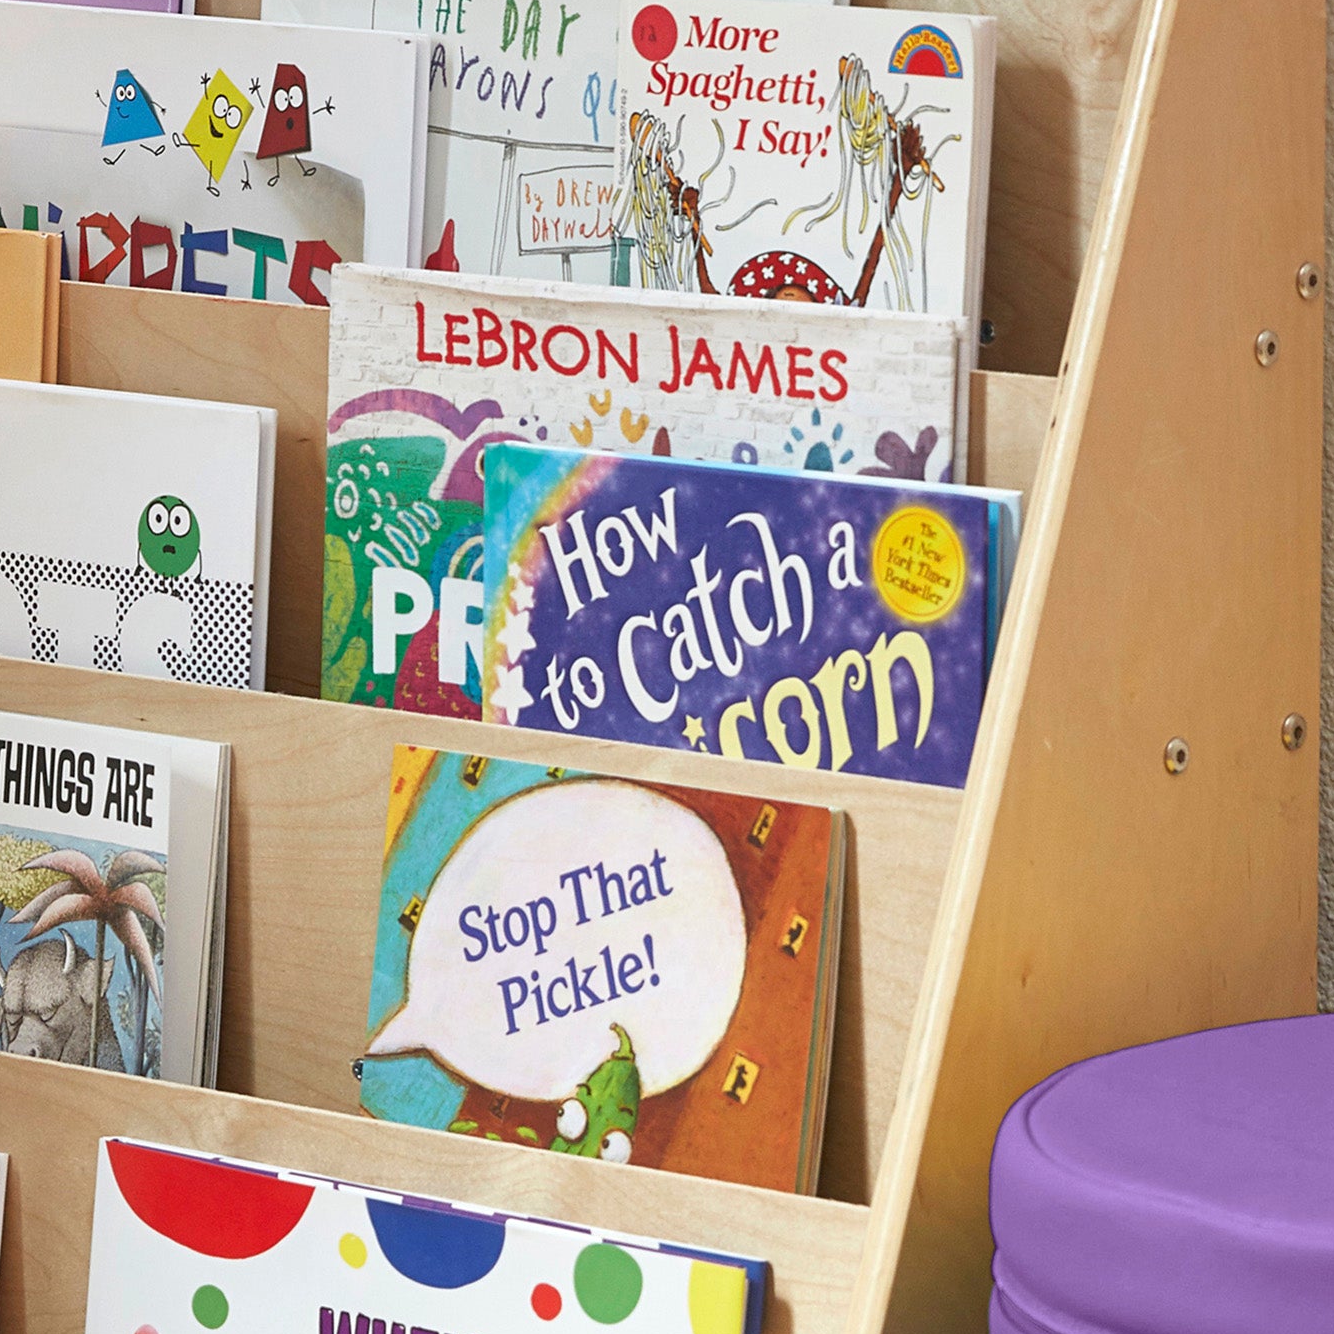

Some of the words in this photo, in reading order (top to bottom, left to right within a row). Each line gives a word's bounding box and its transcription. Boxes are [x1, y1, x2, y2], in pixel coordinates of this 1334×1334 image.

[684, 15, 779, 53] More
[429, 42, 554, 119] AYONS
[646, 61, 826, 114] Spaghetti,
[733, 118, 751, 151] I
[758, 120, 832, 168] Say!
[556, 177, 614, 207] DREW
[659, 325, 849, 402] JAMES
[539, 486, 677, 620] How
[539, 656, 606, 730] to
[616, 512, 814, 724] Catch
[827, 519, 863, 592] a
[103, 757, 156, 828] ARE
[457, 892, 557, 963] Stop
[560, 848, 674, 927] That
[496, 933, 661, 1036] Pickle!
